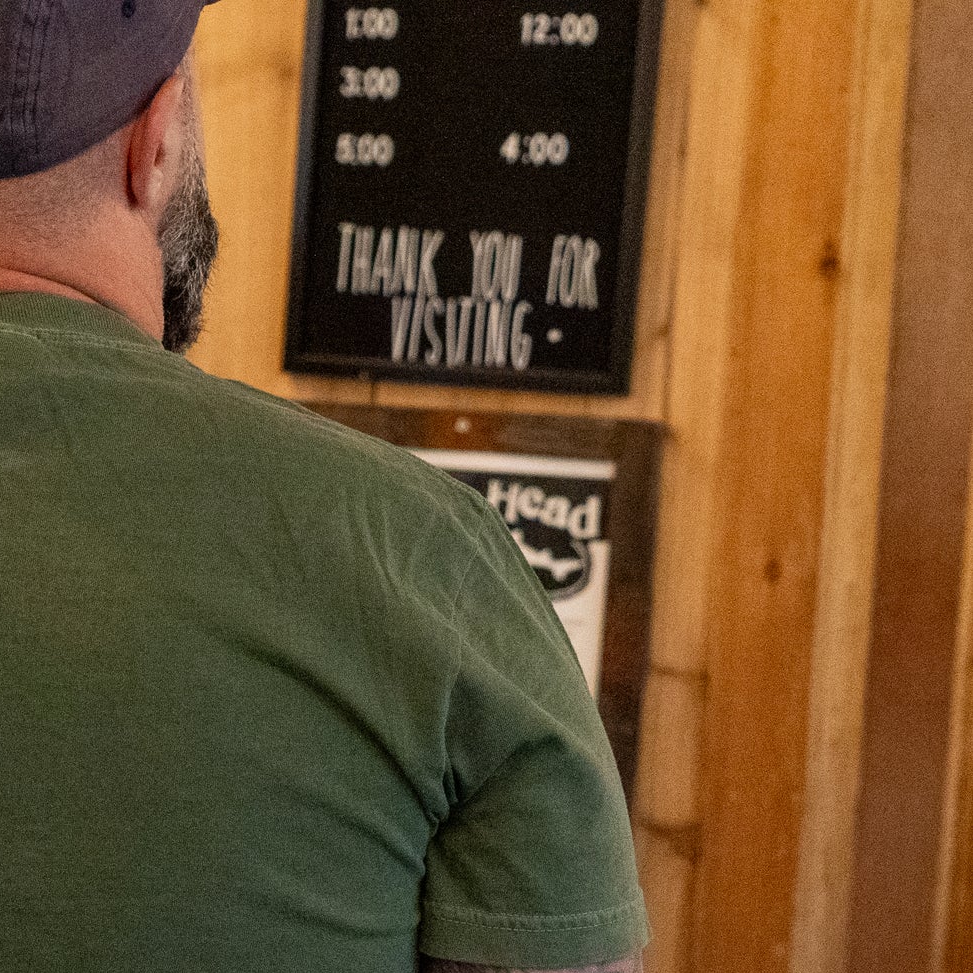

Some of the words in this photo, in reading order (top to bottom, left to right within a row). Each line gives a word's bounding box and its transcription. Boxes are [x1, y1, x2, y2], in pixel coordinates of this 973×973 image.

[521, 12, 599, 47] 12:00
[500, 131, 570, 166] 4:00
[336, 221, 445, 297] THANK
[470, 229, 523, 301] YOU
[546, 234, 601, 310] FOR
[487, 479, 602, 540] Head
